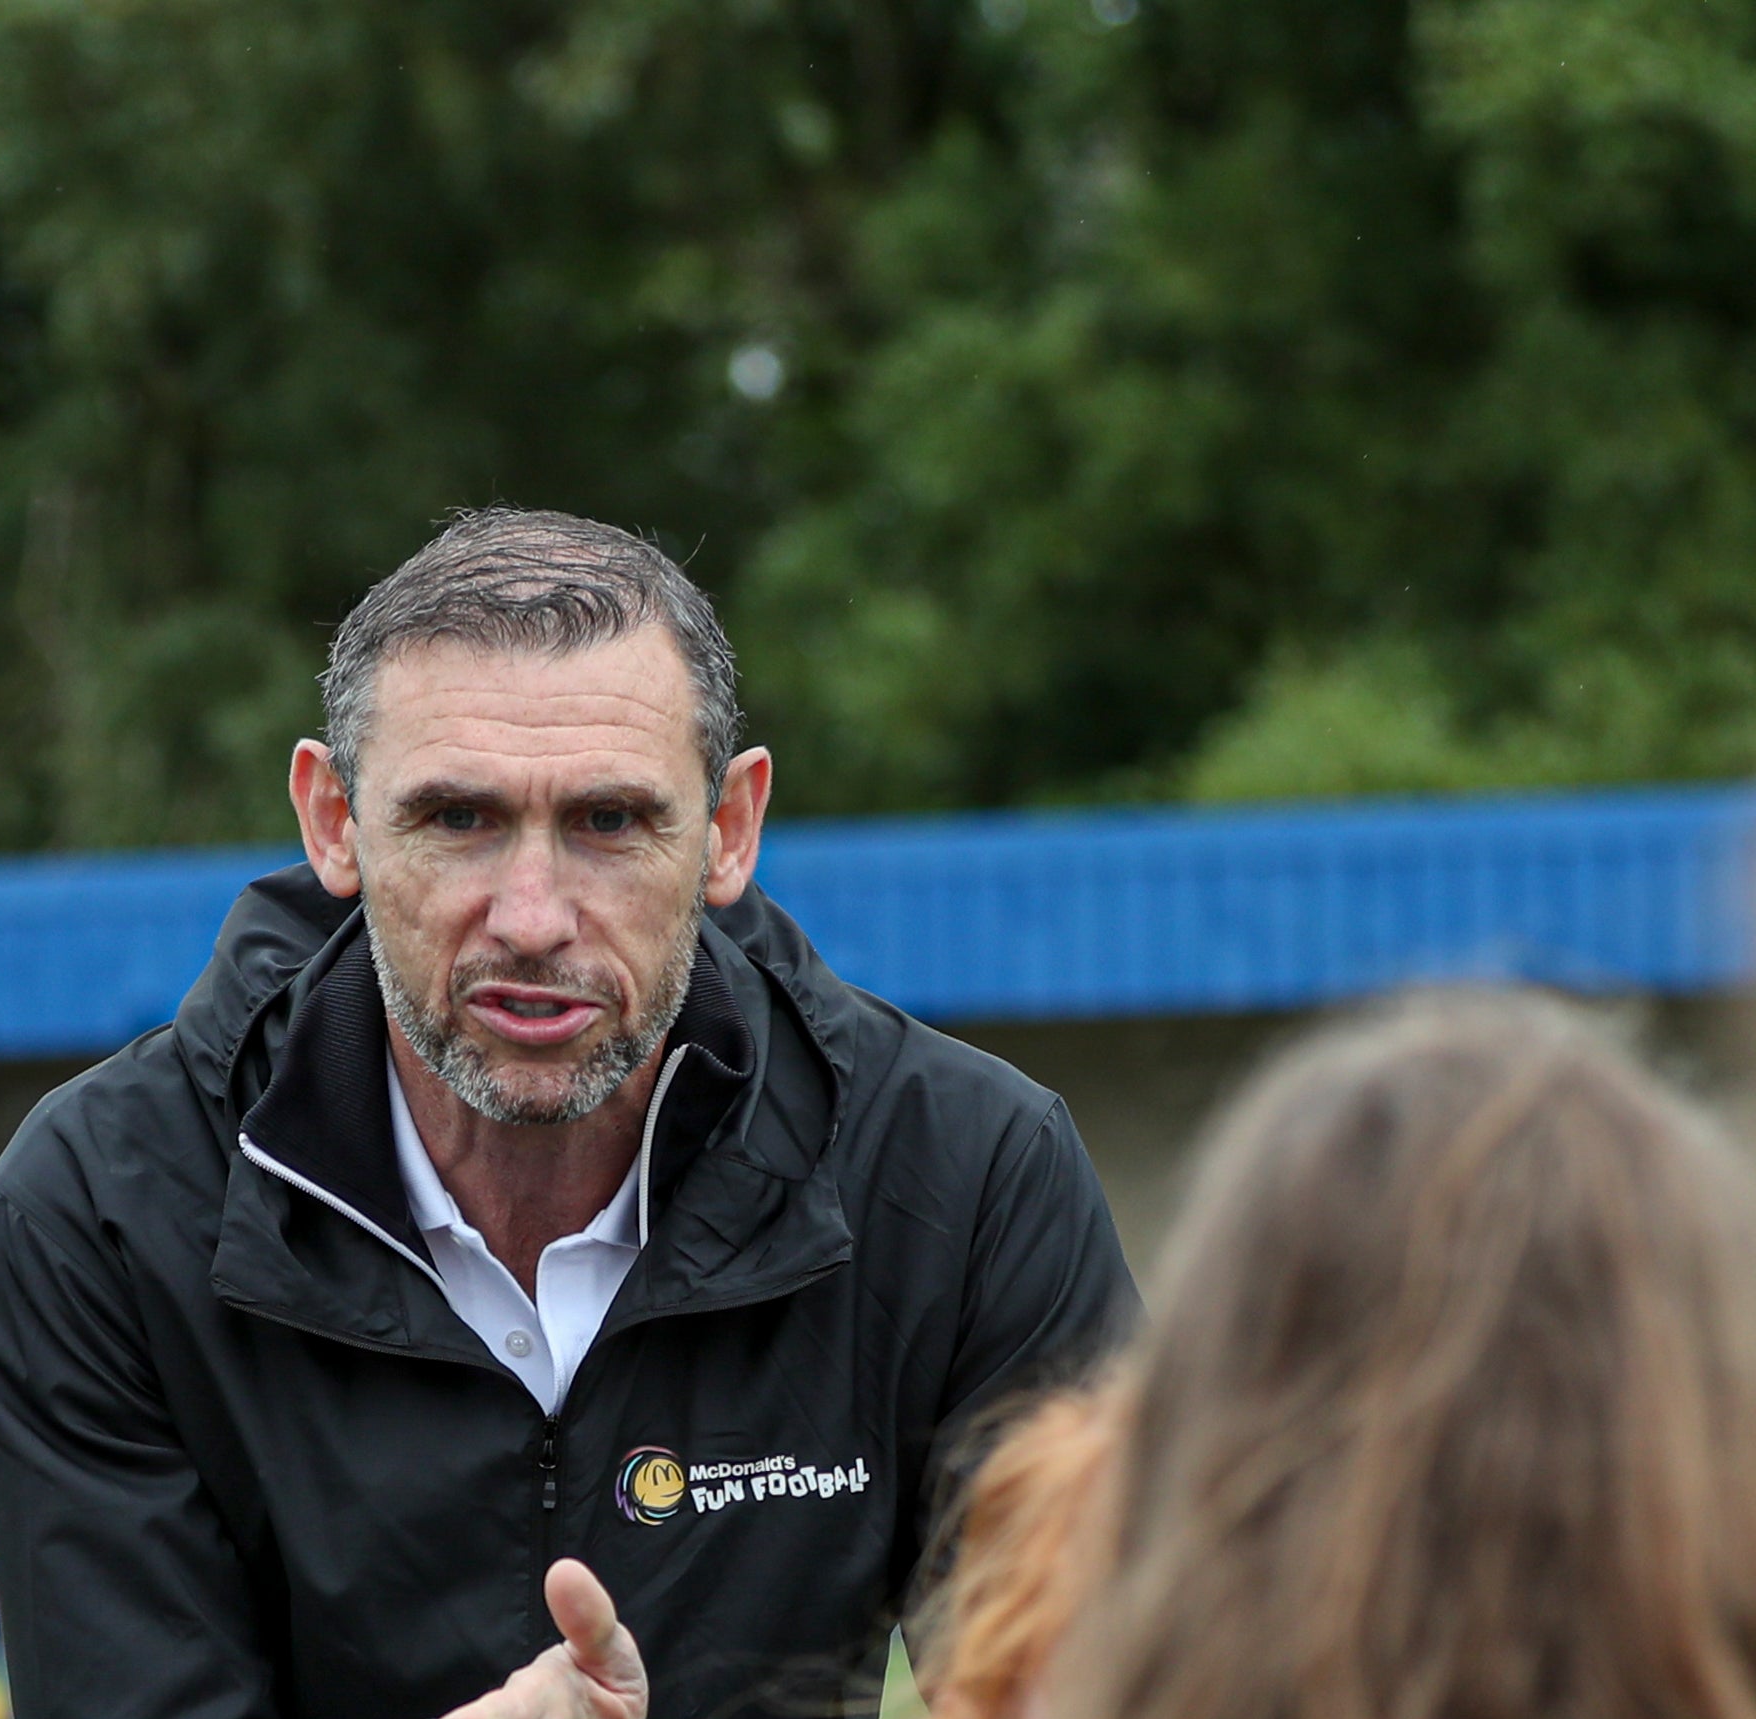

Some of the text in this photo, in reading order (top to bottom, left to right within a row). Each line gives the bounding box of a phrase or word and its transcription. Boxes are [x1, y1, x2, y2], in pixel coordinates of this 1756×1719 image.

[689, 1455, 796, 1482] McDonald's
[691, 1457, 870, 1514] FUN FOOTBALL
